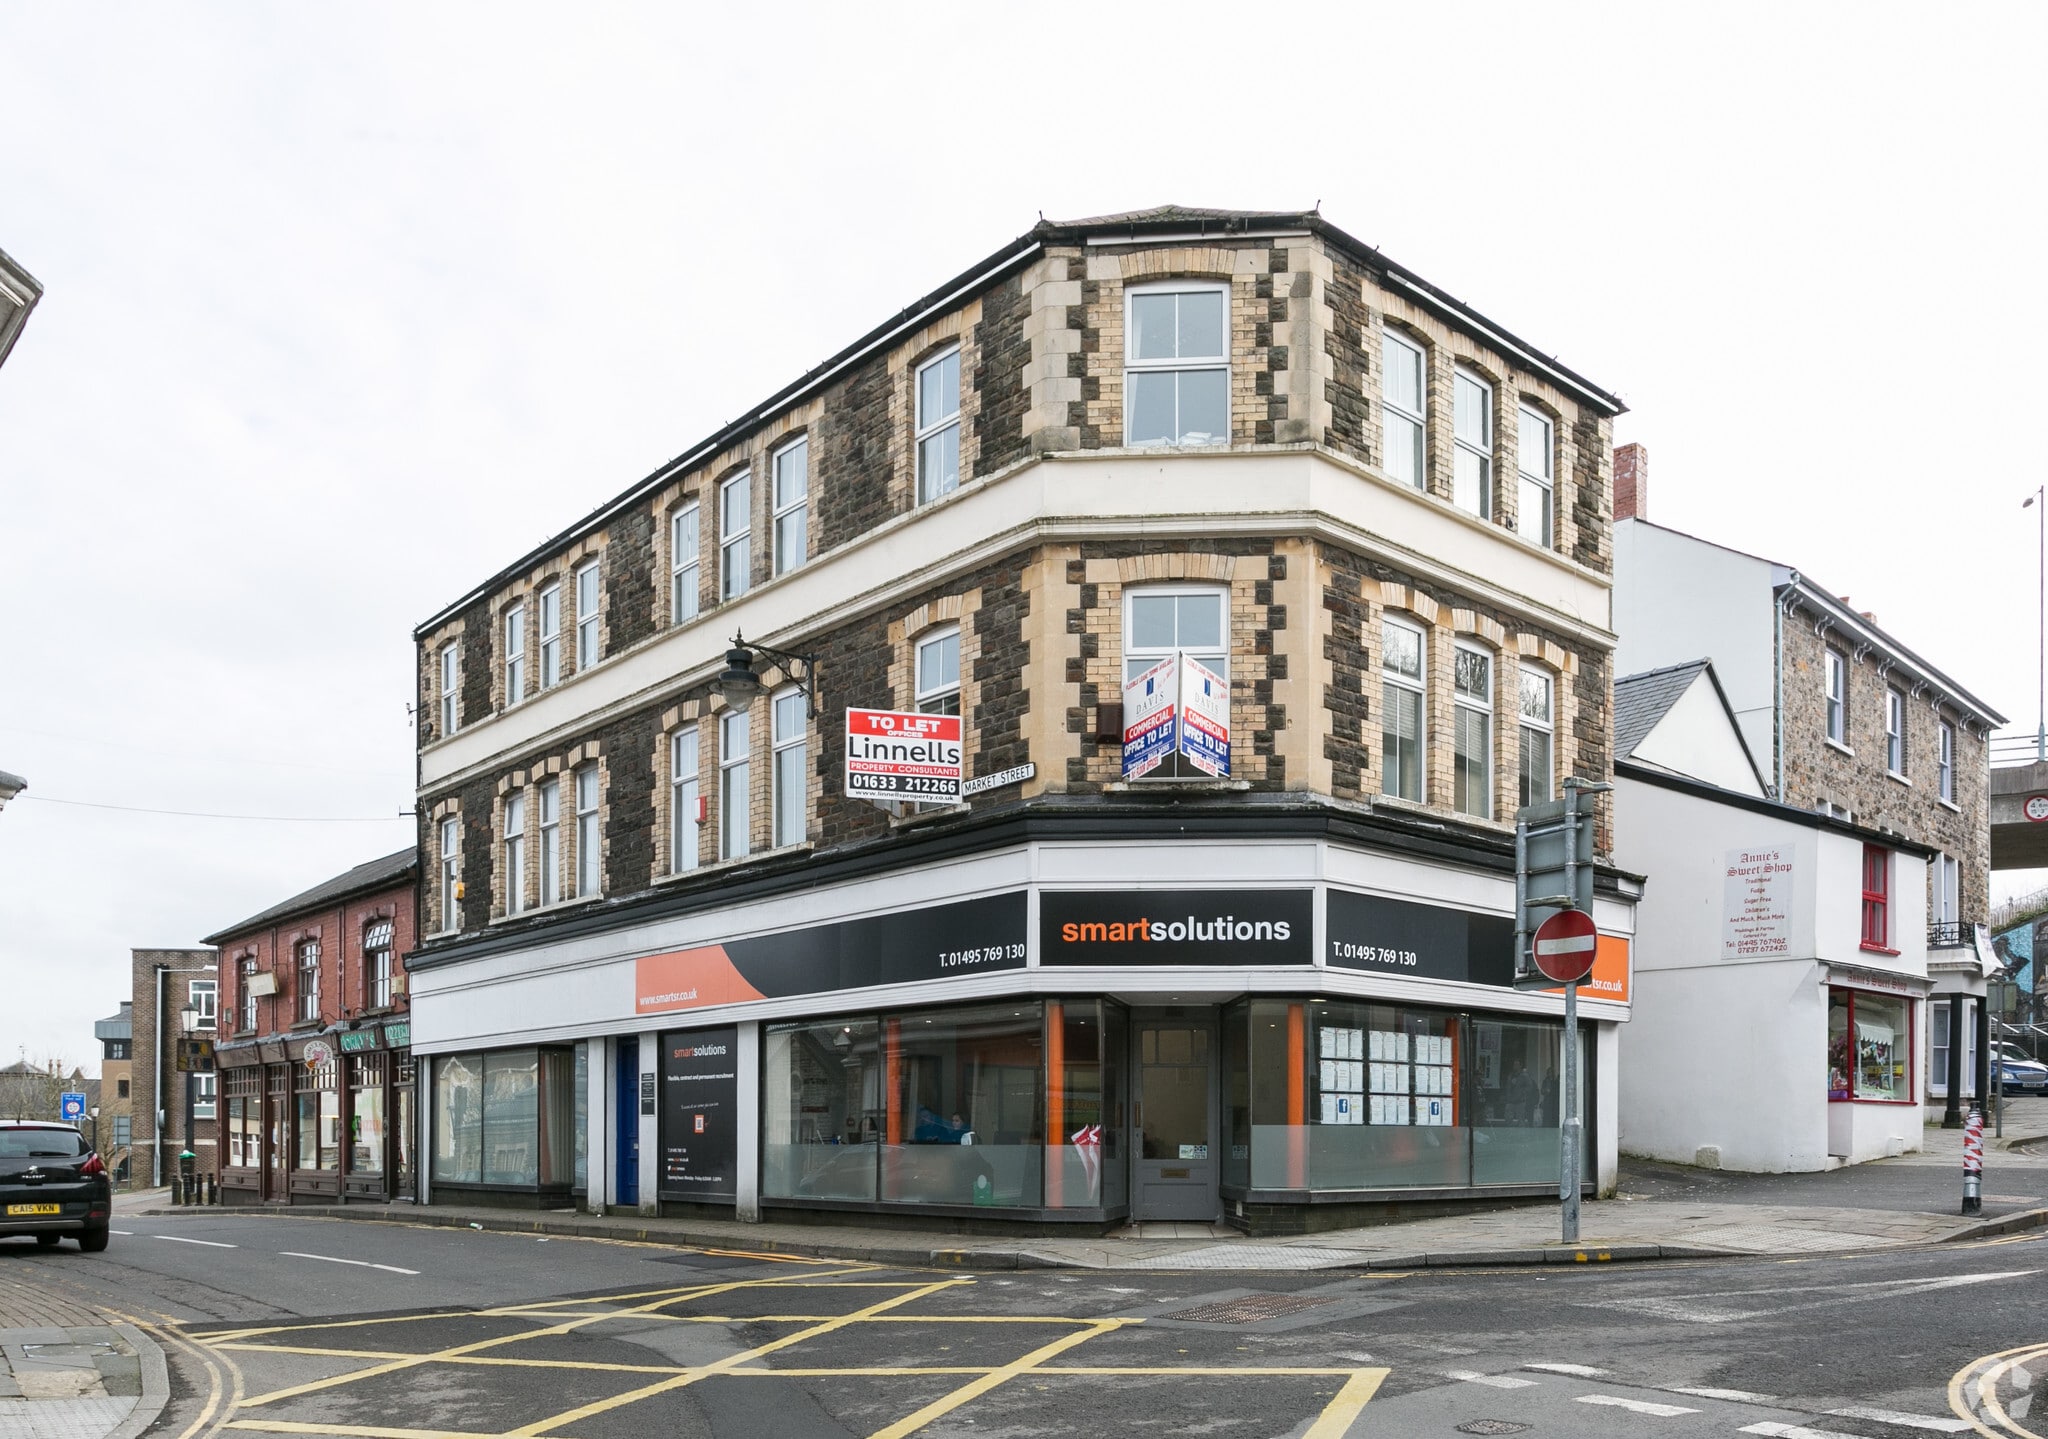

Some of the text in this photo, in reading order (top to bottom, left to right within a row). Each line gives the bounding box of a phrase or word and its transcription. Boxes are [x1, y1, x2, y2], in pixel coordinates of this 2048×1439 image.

[1136, 692, 1164, 714] DAVIS
[1195, 692, 1218, 714] DAVIS
[868, 716, 941, 732] TO LET
[1129, 709, 1170, 739] COMMERCIAL
[1188, 711, 1224, 740] COMMERCIAL
[1125, 736, 1144, 757] OFFICE
[1147, 730, 1156, 744] TO
[1159, 720, 1173, 738] LET
[1184, 723, 1204, 744] OFFICE
[1205, 734, 1214, 749] TO
[1216, 740, 1228, 756] LET
[849, 736, 959, 764] Linnells
[851, 762, 958, 775] PROPERTY CONSULTANTS
[965, 766, 1030, 793] MARKET STREET
[853, 775, 956, 793] 01633 212266
[856, 791, 953, 800] www.linnellsproperty.co.uk
[1740, 851, 1779, 863] Annie's
[1727, 863, 1792, 876] Sweet Shop
[1062, 916, 1290, 942] smartsolutions
[939, 944, 1025, 967] T. 01495 769 130
[1333, 941, 1416, 966] T. 01495 769 130
[640, 988, 697, 1005] www.smartsr.co.uk
[674, 1044, 727, 1058] smartsolutions
[13, 1204, 54, 1213] CA15 VKN
